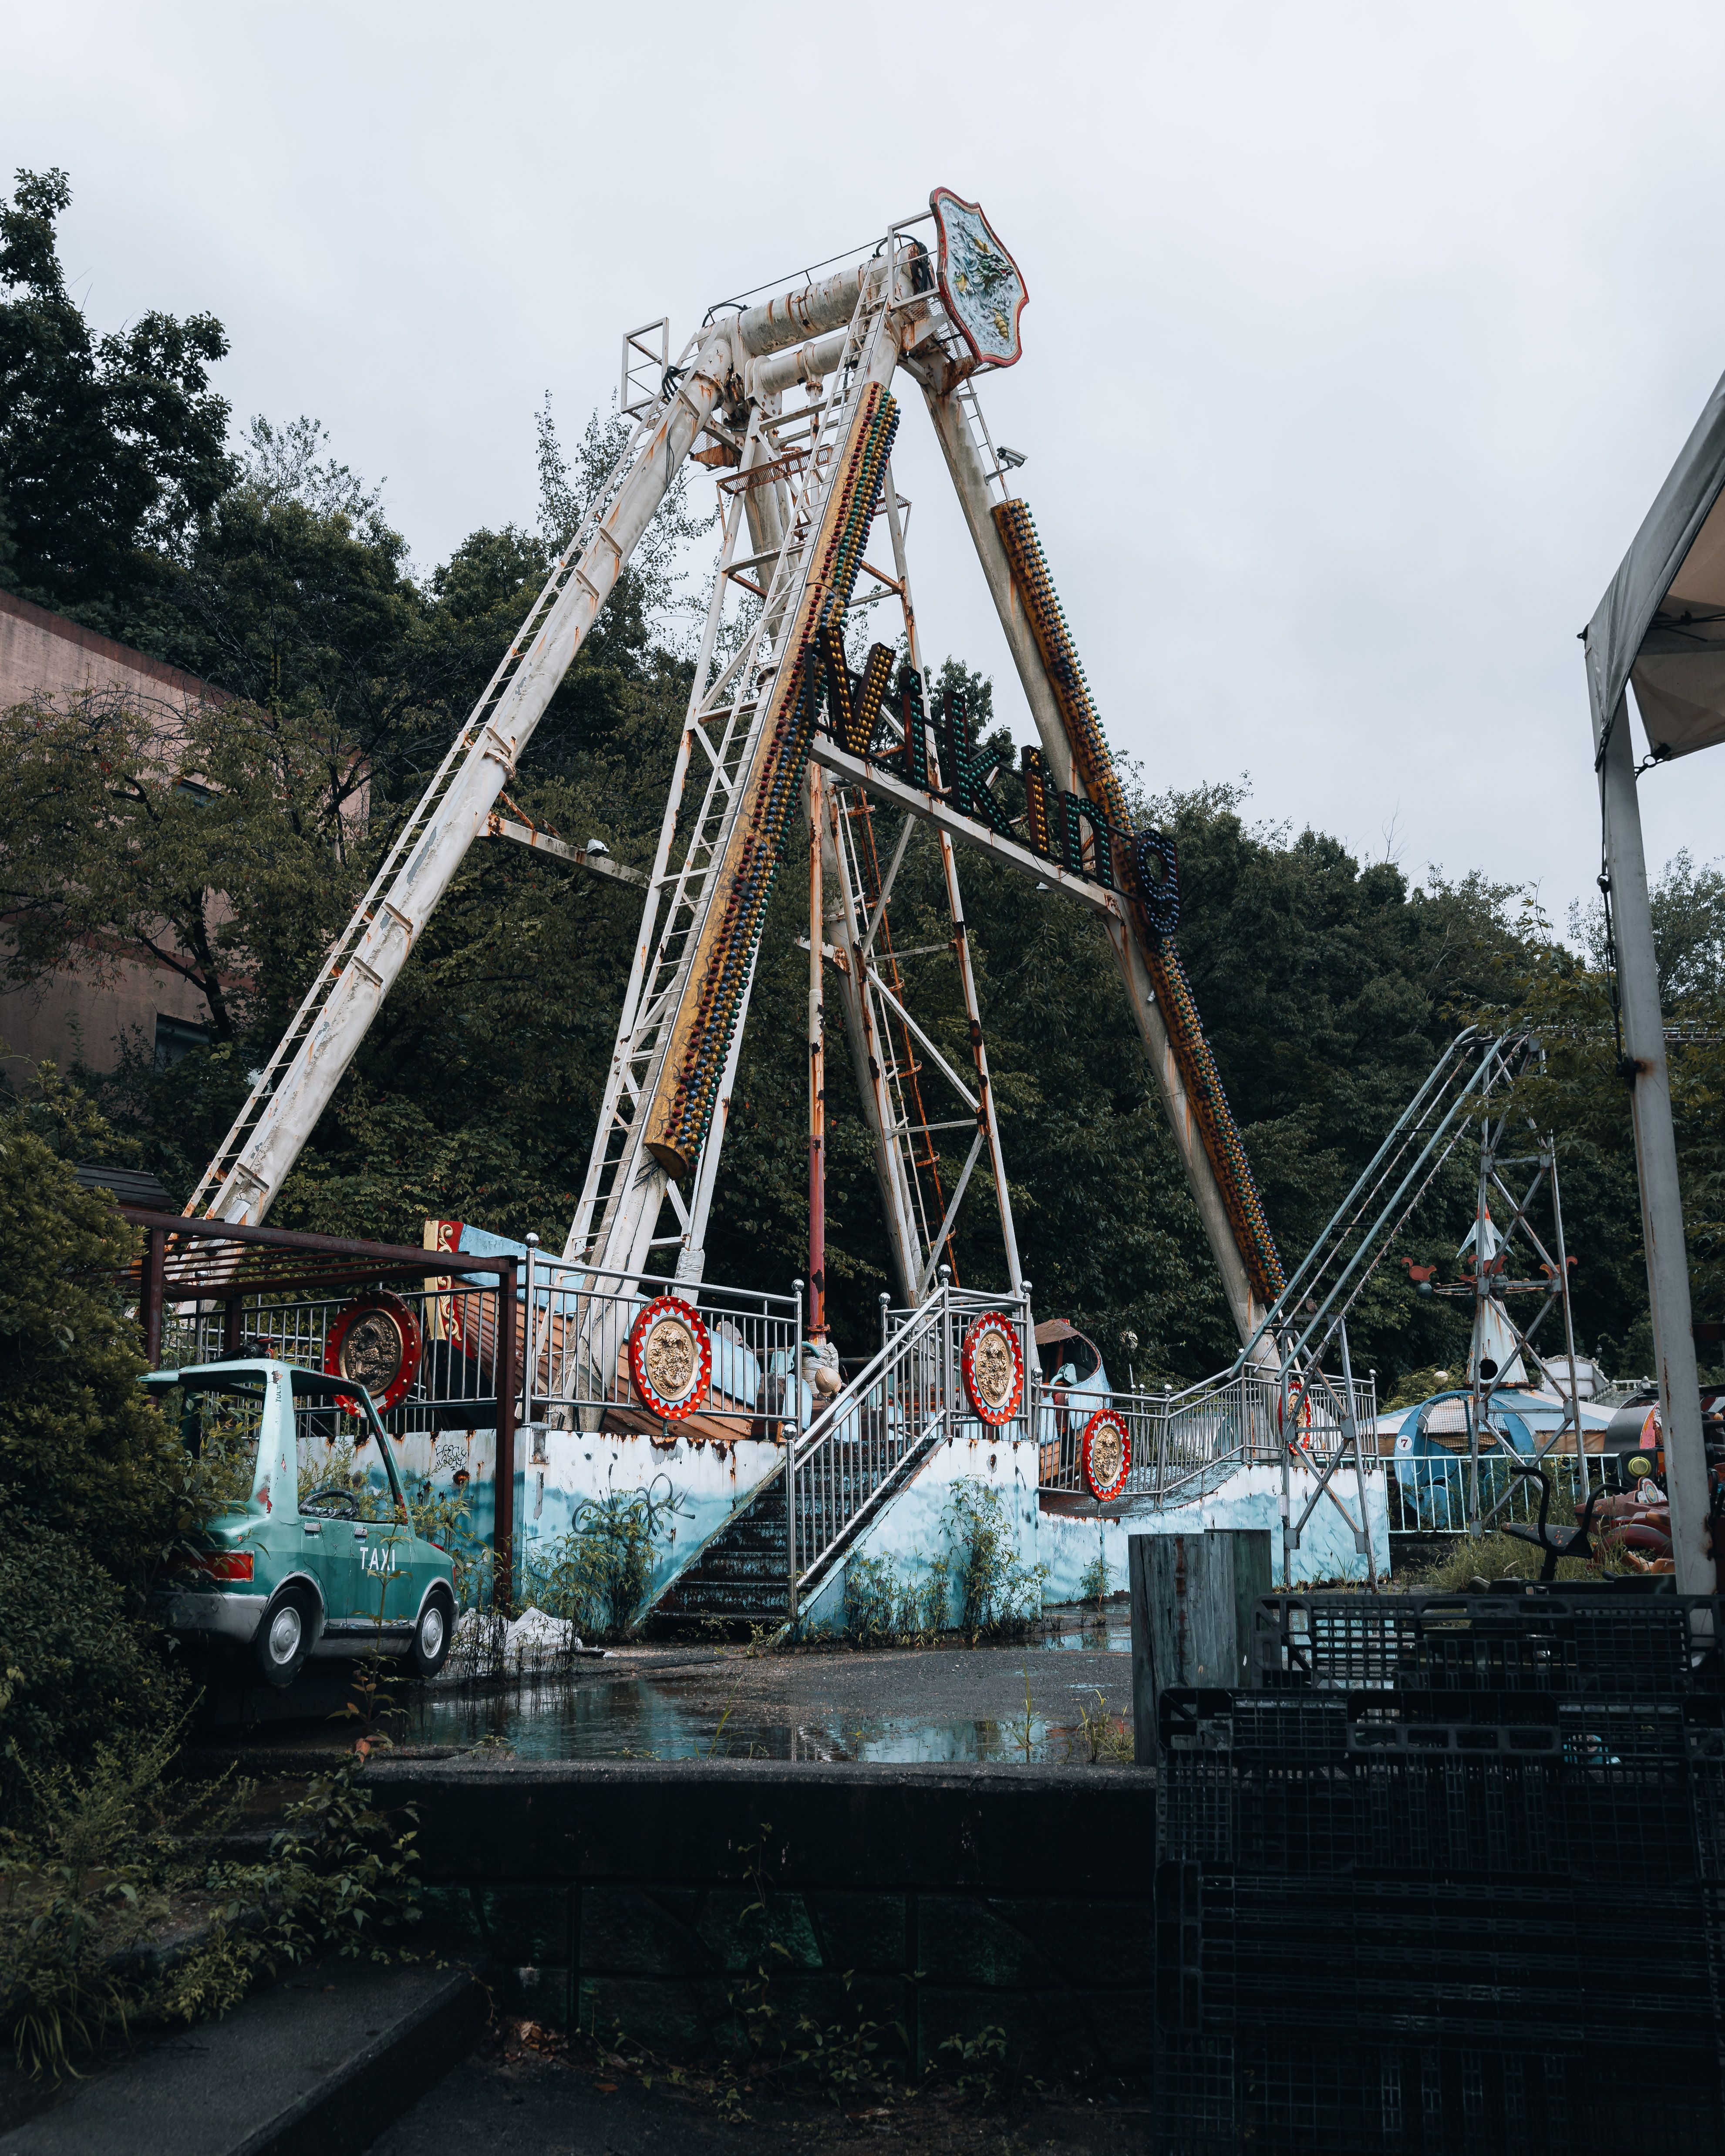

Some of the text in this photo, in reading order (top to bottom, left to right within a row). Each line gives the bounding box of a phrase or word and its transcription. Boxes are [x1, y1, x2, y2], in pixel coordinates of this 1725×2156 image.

[817, 625, 1179, 936] Viking
[1401, 1439, 1408, 1448] 7
[360, 1546, 395, 1571] TAXI
